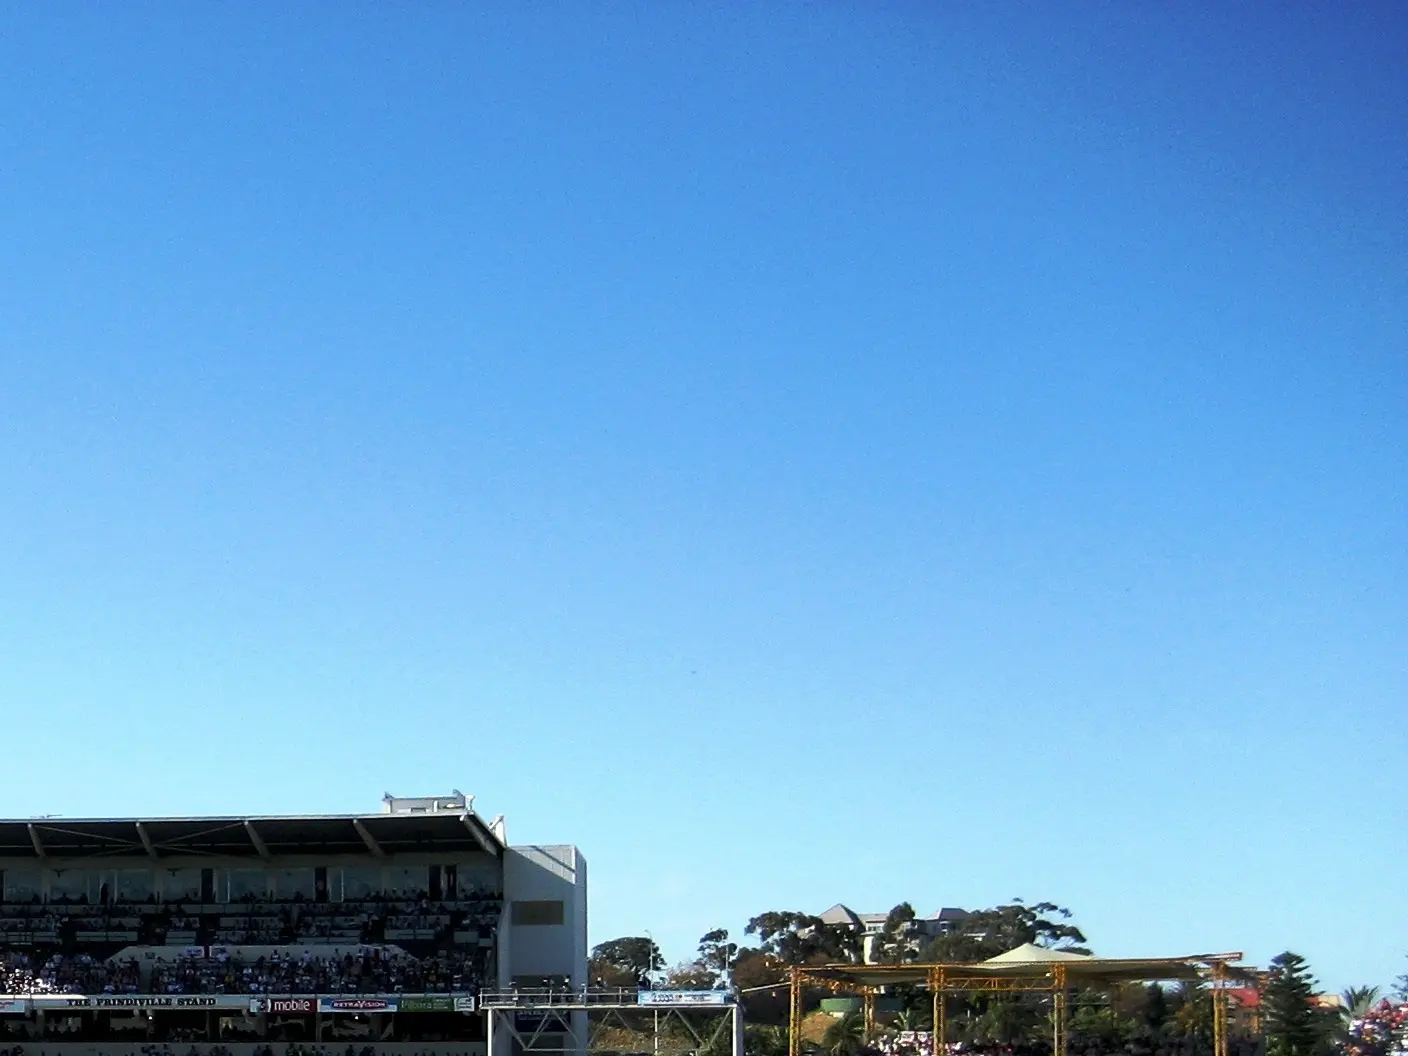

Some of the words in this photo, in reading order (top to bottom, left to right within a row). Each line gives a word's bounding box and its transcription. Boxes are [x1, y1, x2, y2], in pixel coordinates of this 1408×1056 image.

[67, 998, 91, 1007] THE
[177, 998, 216, 1007] STAND
[274, 998, 311, 1011] mobile
